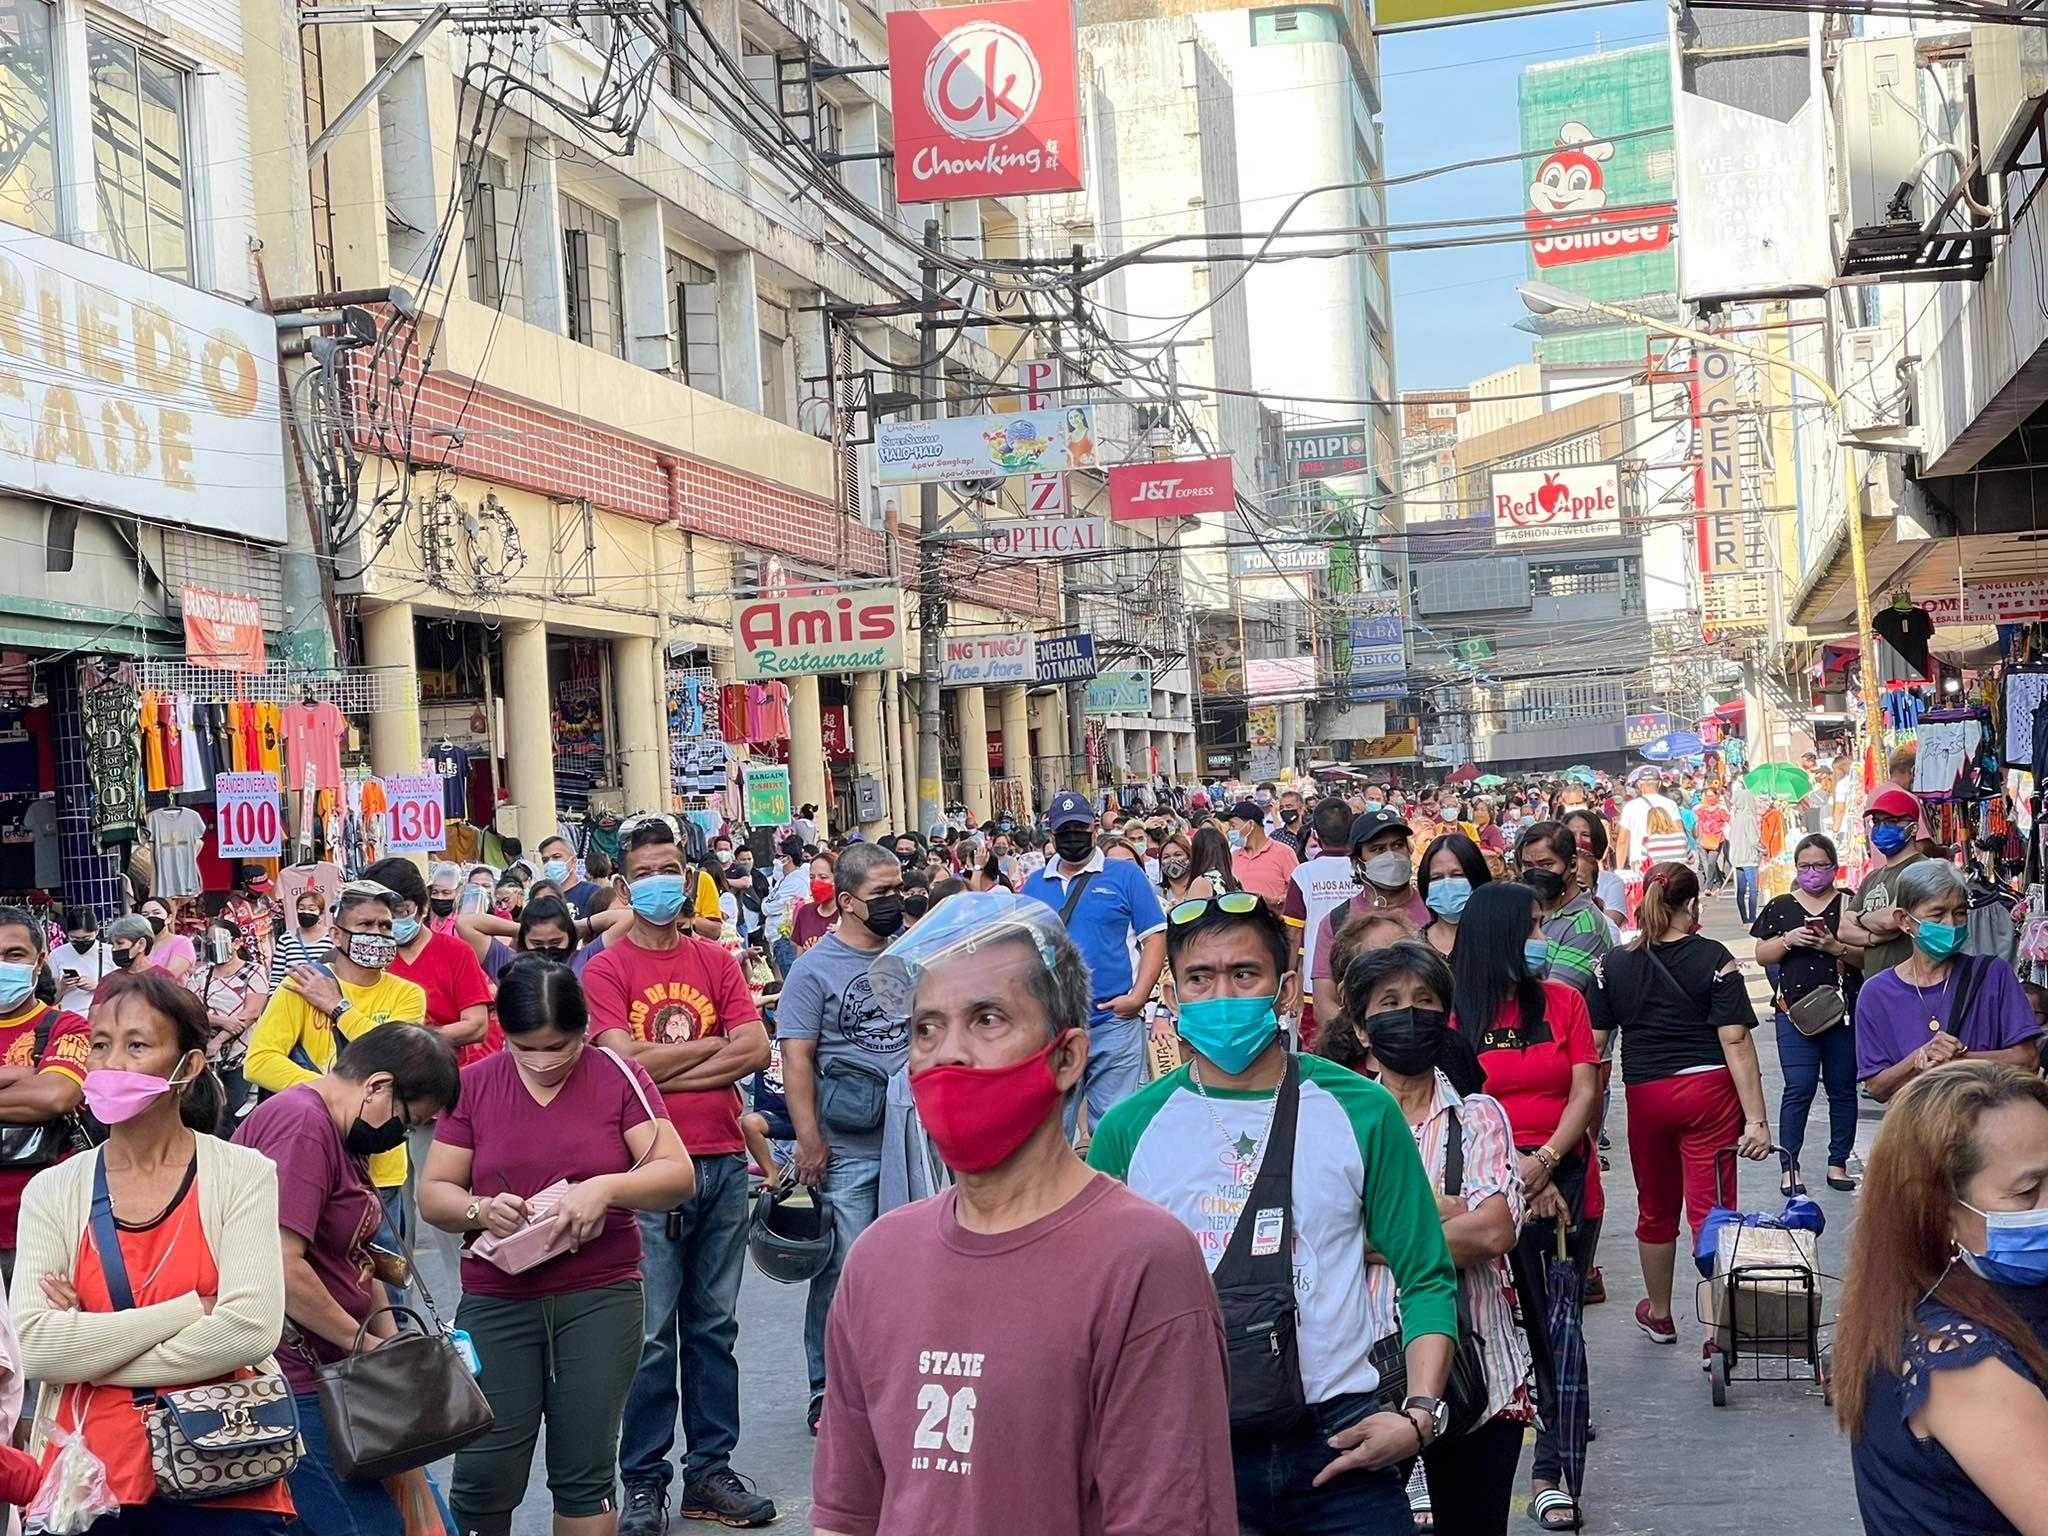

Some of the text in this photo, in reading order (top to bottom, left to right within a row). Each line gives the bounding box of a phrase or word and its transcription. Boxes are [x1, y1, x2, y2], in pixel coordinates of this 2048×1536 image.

[912, 143, 1041, 180] Chowking
[878, 444, 944, 463] HALO-HALO
[1131, 478, 1214, 502] J&T EXPRESS
[1707, 398, 1738, 566] CENTER
[1496, 486, 1616, 527] Red Apple
[992, 523, 1103, 553] OPTICAL
[1504, 523, 1610, 541] FASHION JEWELLERY
[1279, 551, 1327, 567] SILVER
[1990, 590, 2026, 600] PARTY
[740, 597, 895, 653] Amis
[977, 636, 1026, 658] TING'S
[755, 646, 885, 674] Restaurant
[1353, 653, 1402, 667] SEIKO
[217, 776, 278, 793] BRANDED OVERRUNS
[749, 771, 784, 781] BARGAIN
[219, 800, 277, 846] 100
[388, 799, 442, 841] 130
[291, 885, 325, 896] GUSS
[1312, 880, 1338, 891] HIJOS
[918, 1350, 985, 1377] STATE
[913, 1383, 977, 1454] 26
